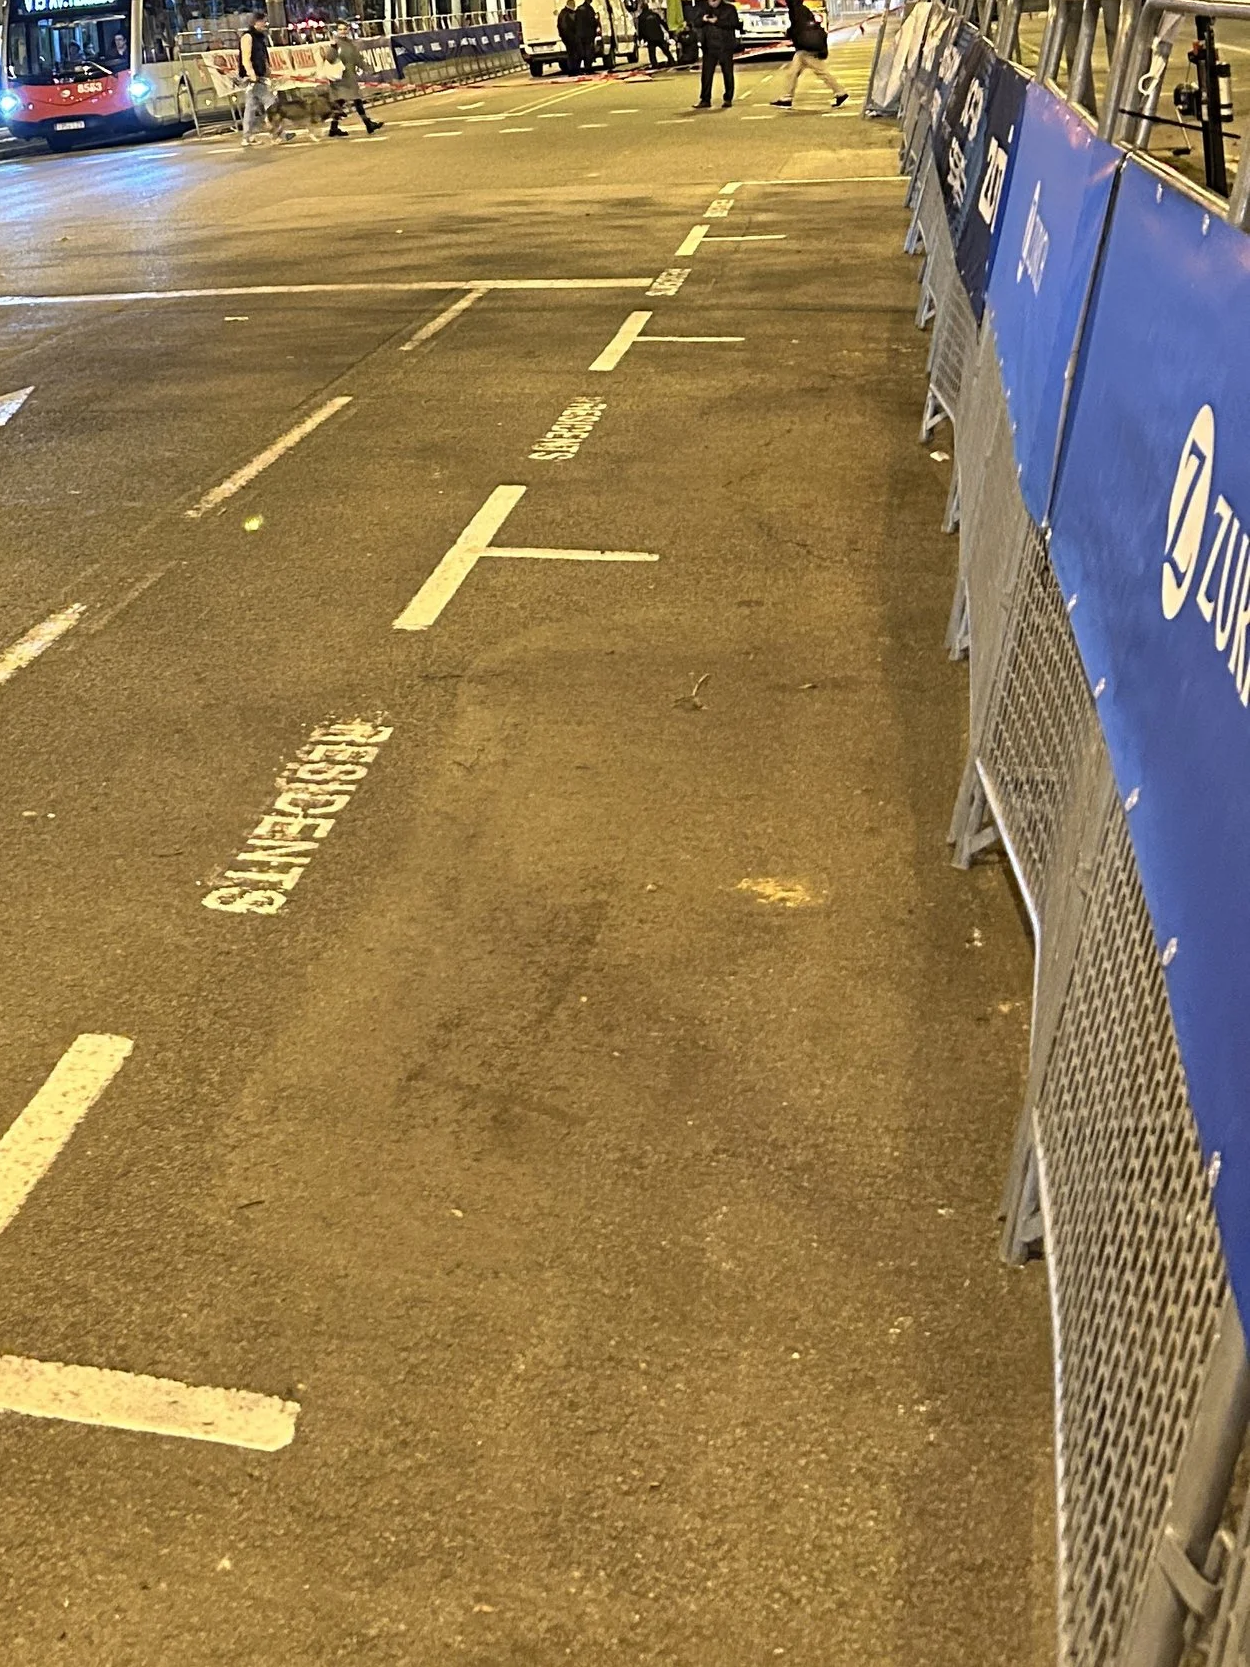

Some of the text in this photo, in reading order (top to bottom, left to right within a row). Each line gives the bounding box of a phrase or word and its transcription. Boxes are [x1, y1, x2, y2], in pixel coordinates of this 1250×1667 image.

[528, 396, 608, 461] RESIDENTS
[1196, 493, 1250, 709] ZUR
[200, 714, 394, 915] RESIDENTS
